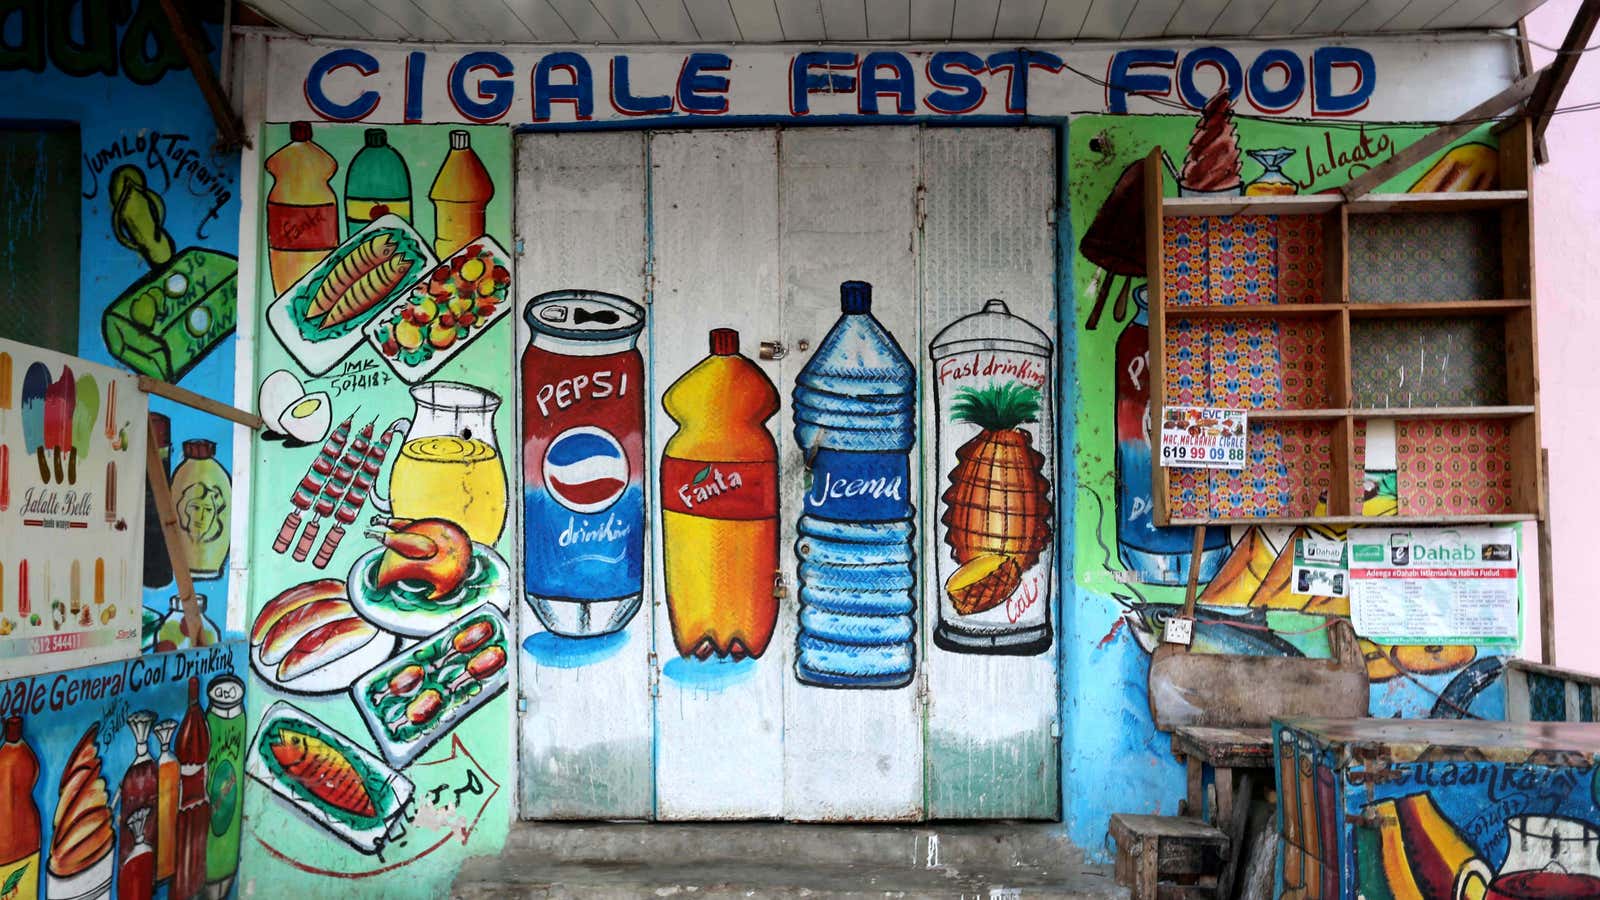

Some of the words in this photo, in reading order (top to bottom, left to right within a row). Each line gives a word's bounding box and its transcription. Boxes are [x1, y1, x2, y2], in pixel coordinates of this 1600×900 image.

[304, 47, 732, 124] CIGALE
[788, 48, 1066, 116] FAST
[1104, 46, 1377, 117] FOOD
[939, 353, 980, 386] Fast
[536, 370, 628, 417] PEPSI
[1163, 446, 1187, 459] 619
[1190, 447, 1206, 460] 99
[1209, 447, 1225, 461] 09
[1228, 448, 1244, 461] 88
[1219, 436, 1245, 450] CIGALE
[677, 468, 743, 509] Fanta
[809, 472, 903, 507] Jeema
[1413, 544, 1476, 561] Dahab
[49, 661, 128, 712] General
[129, 656, 167, 692] Cool
